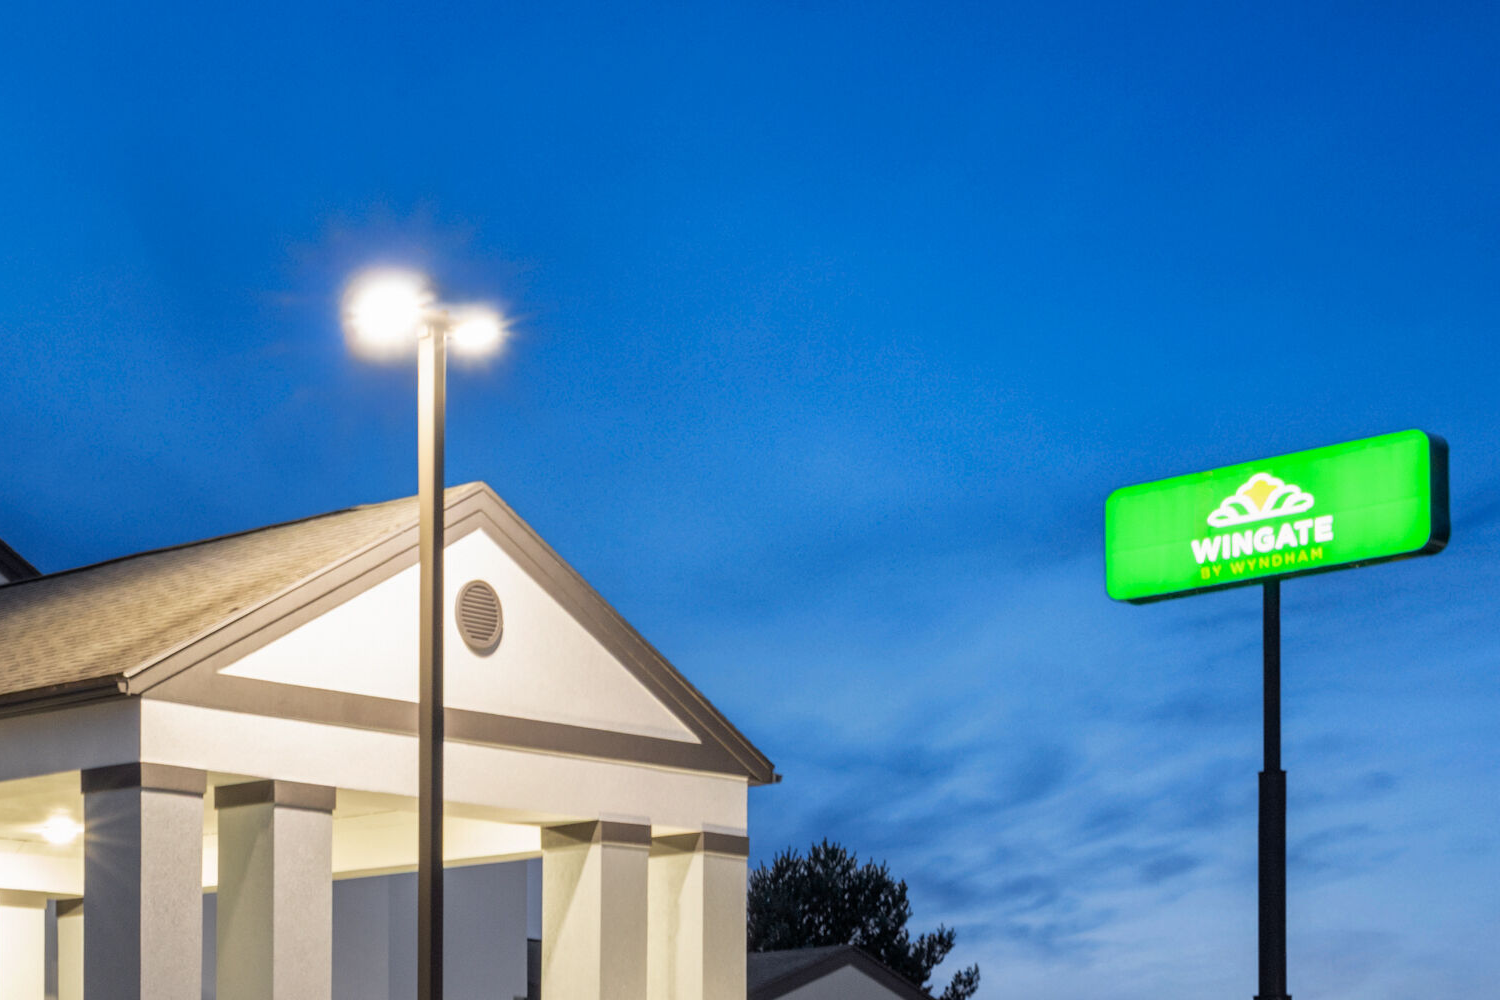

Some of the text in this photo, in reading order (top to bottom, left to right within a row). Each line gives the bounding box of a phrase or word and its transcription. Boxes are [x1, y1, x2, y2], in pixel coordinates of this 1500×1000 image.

[1191, 516, 1333, 564] WINGATE
[1201, 548, 1323, 580] BY WYNDHAM
